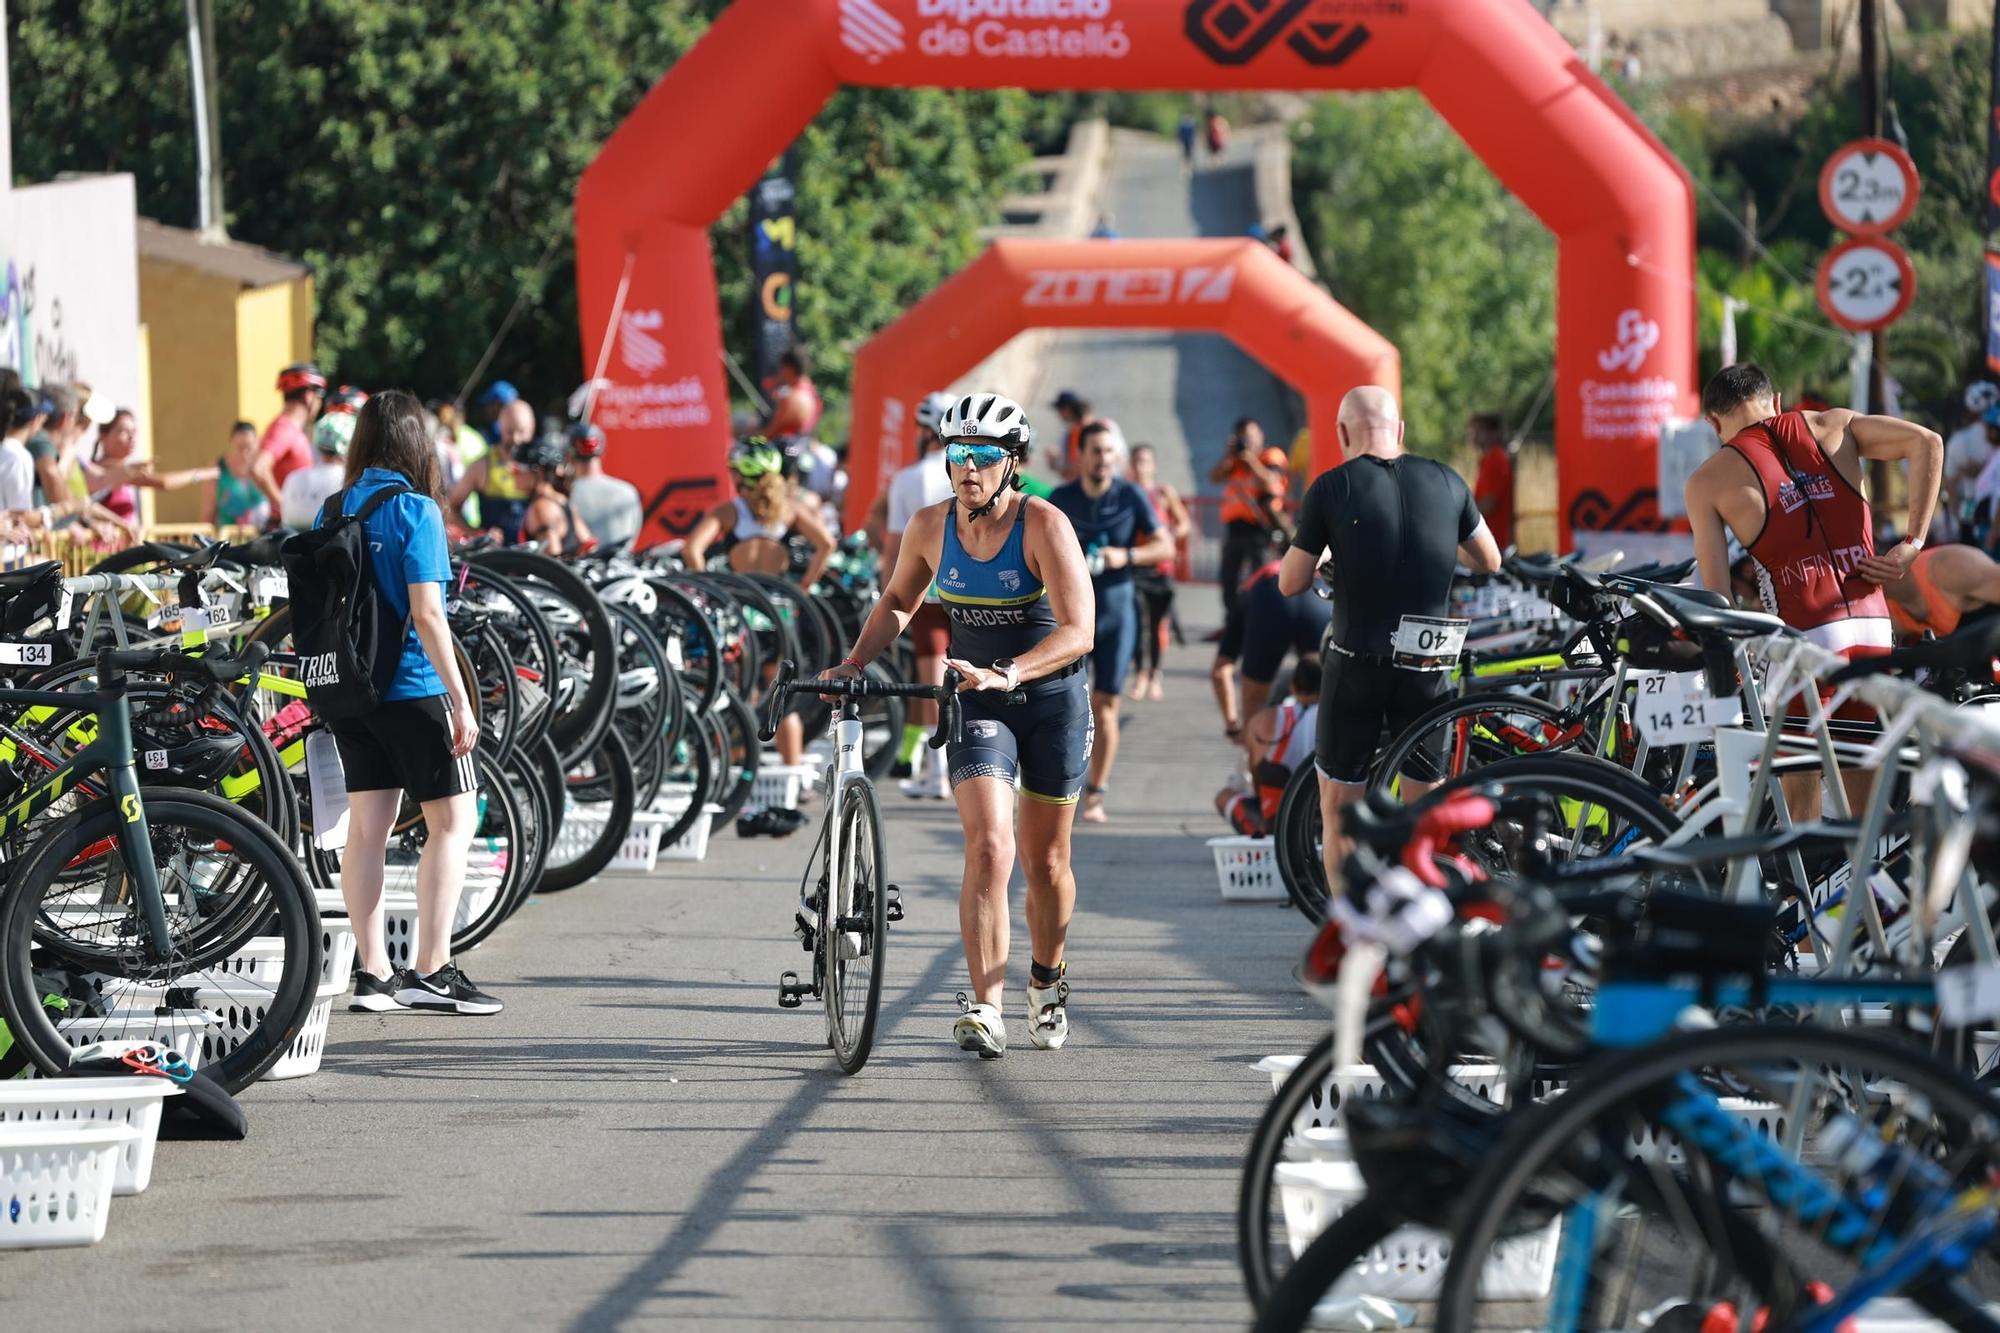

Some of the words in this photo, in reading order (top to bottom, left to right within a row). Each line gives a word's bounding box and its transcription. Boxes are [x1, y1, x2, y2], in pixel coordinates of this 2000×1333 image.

[918, 21, 969, 56] de
[974, 21, 1130, 57] Castelló
[962, 425, 978, 435] 169
[943, 578, 966, 590] VIATOR
[160, 603, 180, 620] 165
[205, 607, 227, 624] 162
[951, 607, 1025, 627] CARDETE
[1418, 629, 1448, 651] 40
[17, 646, 47, 662] 134
[306, 674, 340, 688] OFICIALS
[1645, 676, 1666, 694] 27
[1649, 713, 1674, 732] 14
[1682, 704, 1706, 725] 21
[148, 752, 165, 763] 131
